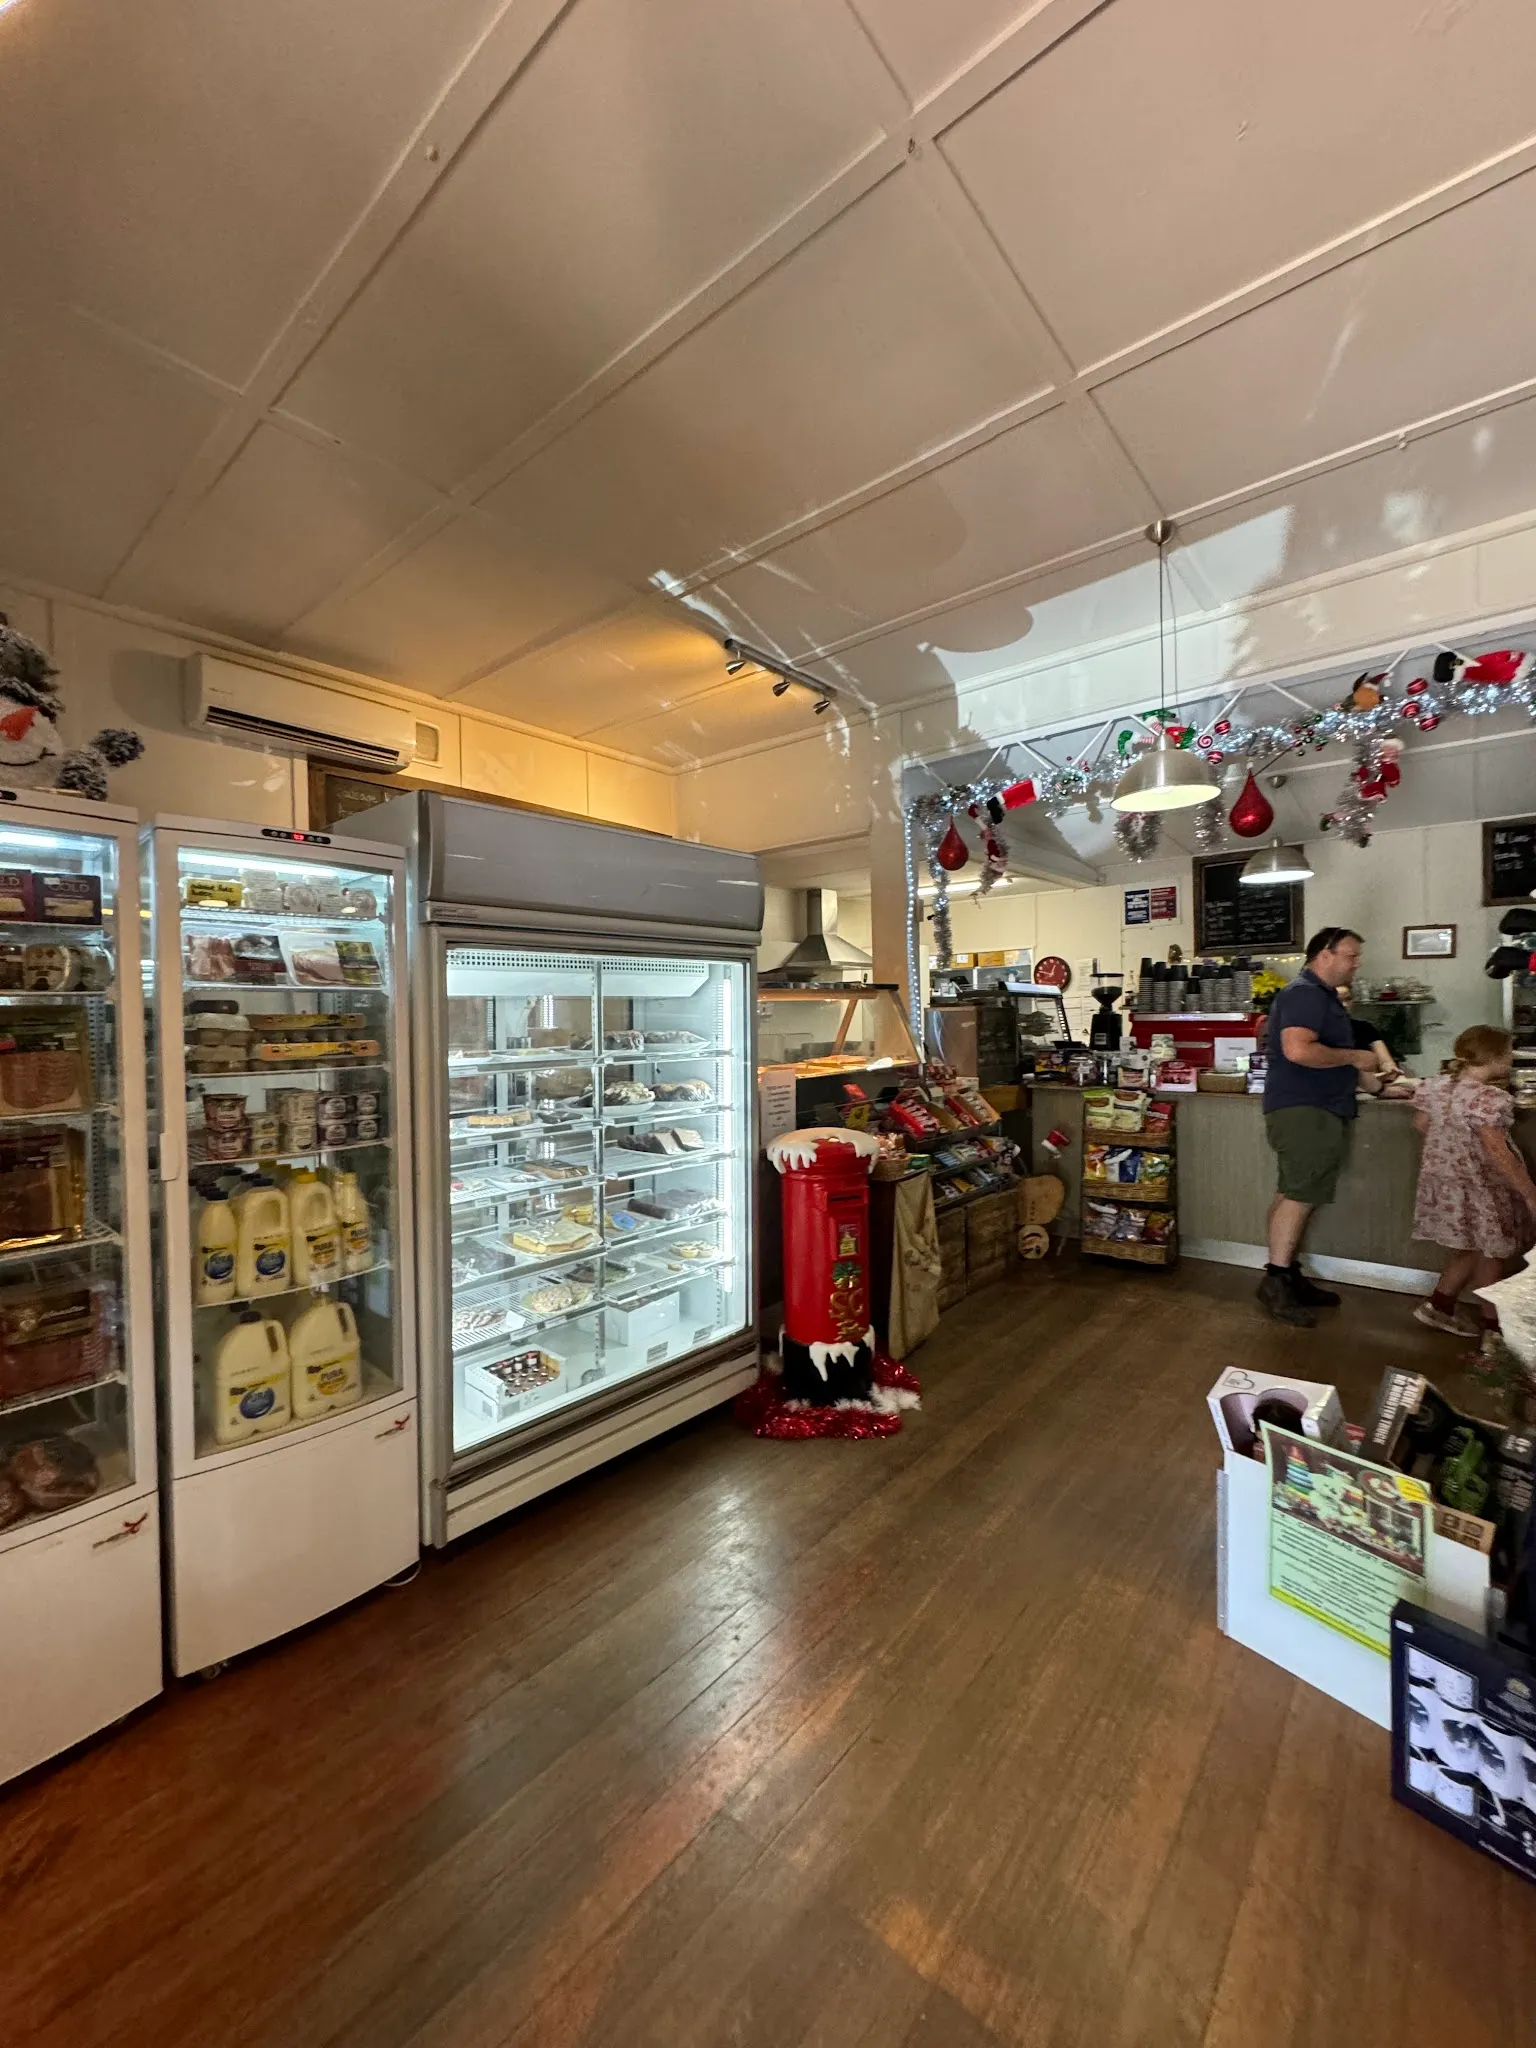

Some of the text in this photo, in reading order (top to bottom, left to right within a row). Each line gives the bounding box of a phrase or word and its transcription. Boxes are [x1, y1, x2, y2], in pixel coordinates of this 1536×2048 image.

[48, 882, 90, 893] GOLD
[1381, 1384, 1403, 1420] MONSTER
[1372, 1419, 1392, 1446] TRUCK
